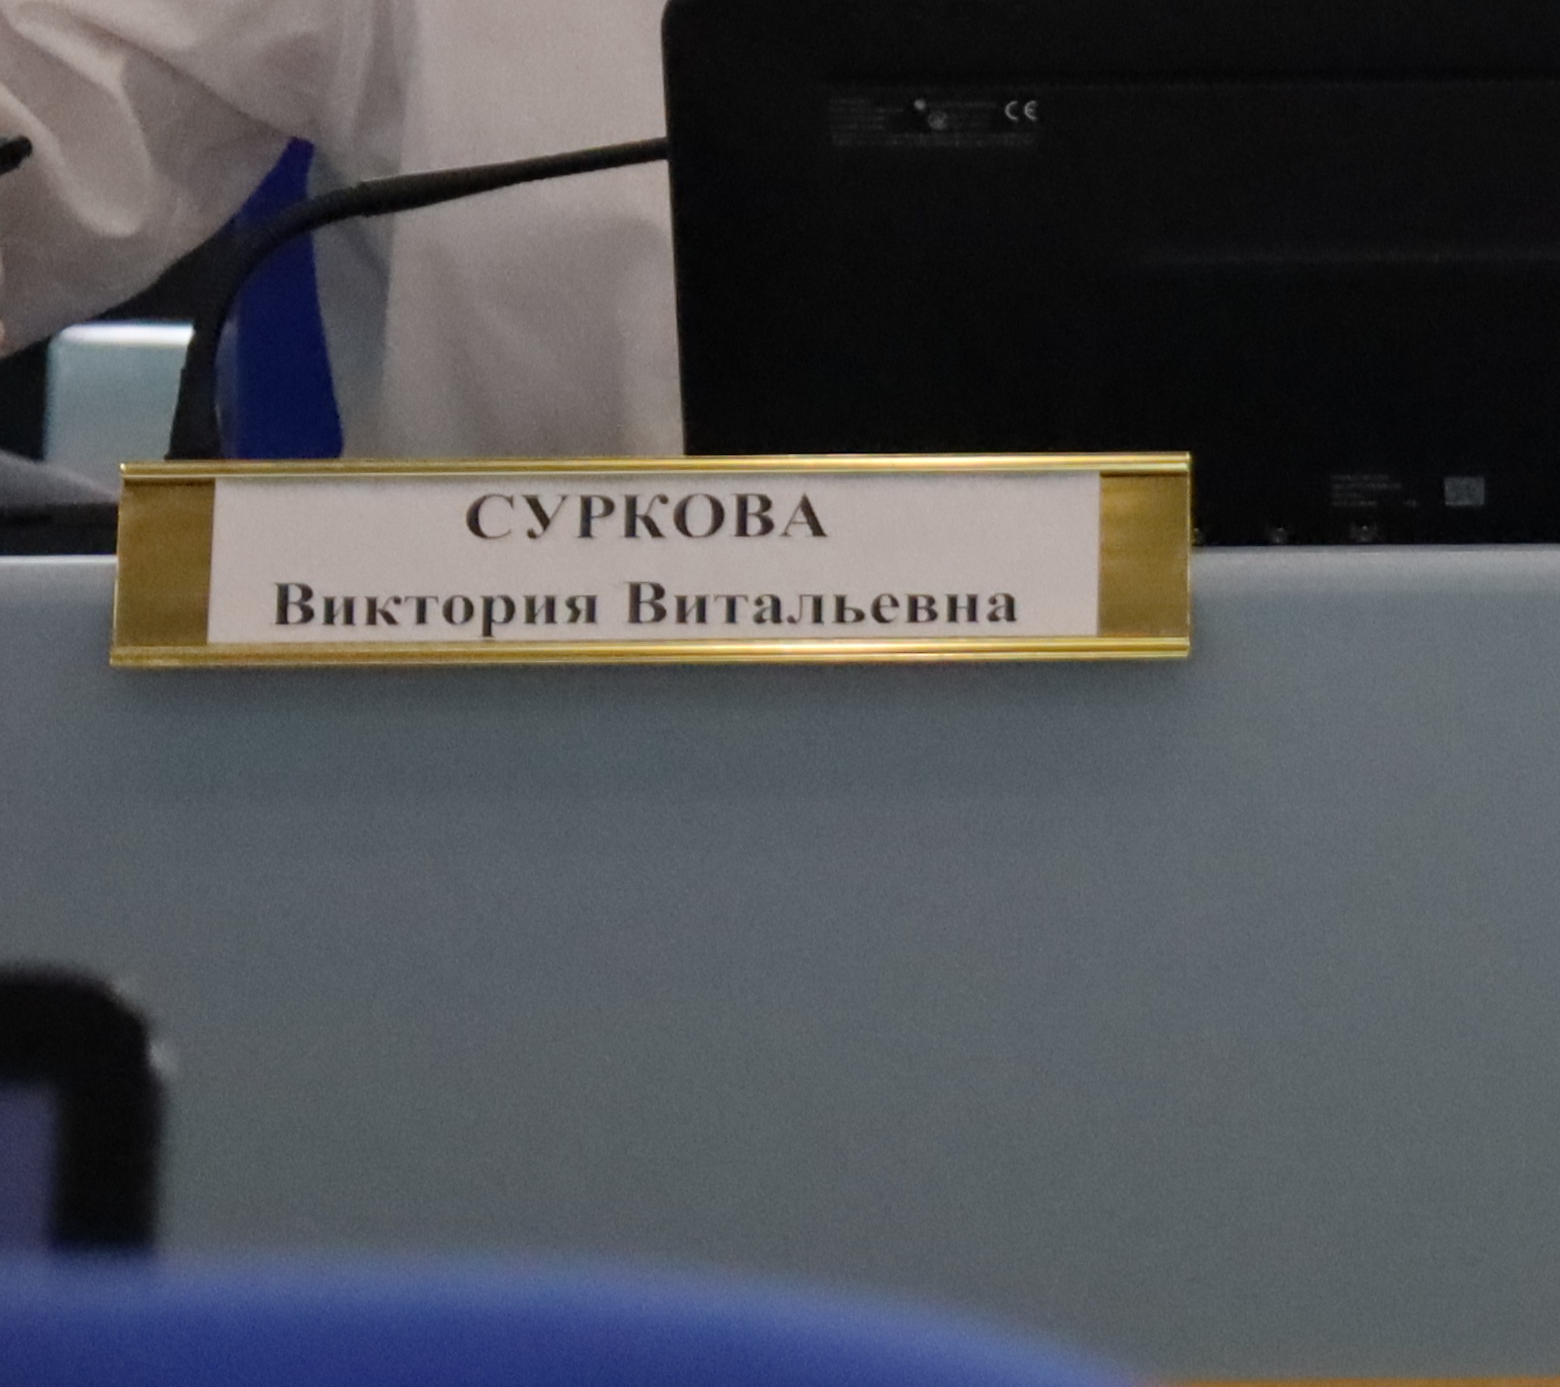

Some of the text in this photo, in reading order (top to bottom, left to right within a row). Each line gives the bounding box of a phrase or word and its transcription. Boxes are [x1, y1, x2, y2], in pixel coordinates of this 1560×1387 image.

[465, 493, 828, 541] СУРКОВА
[274, 581, 1018, 637] Виктория Витальевна
